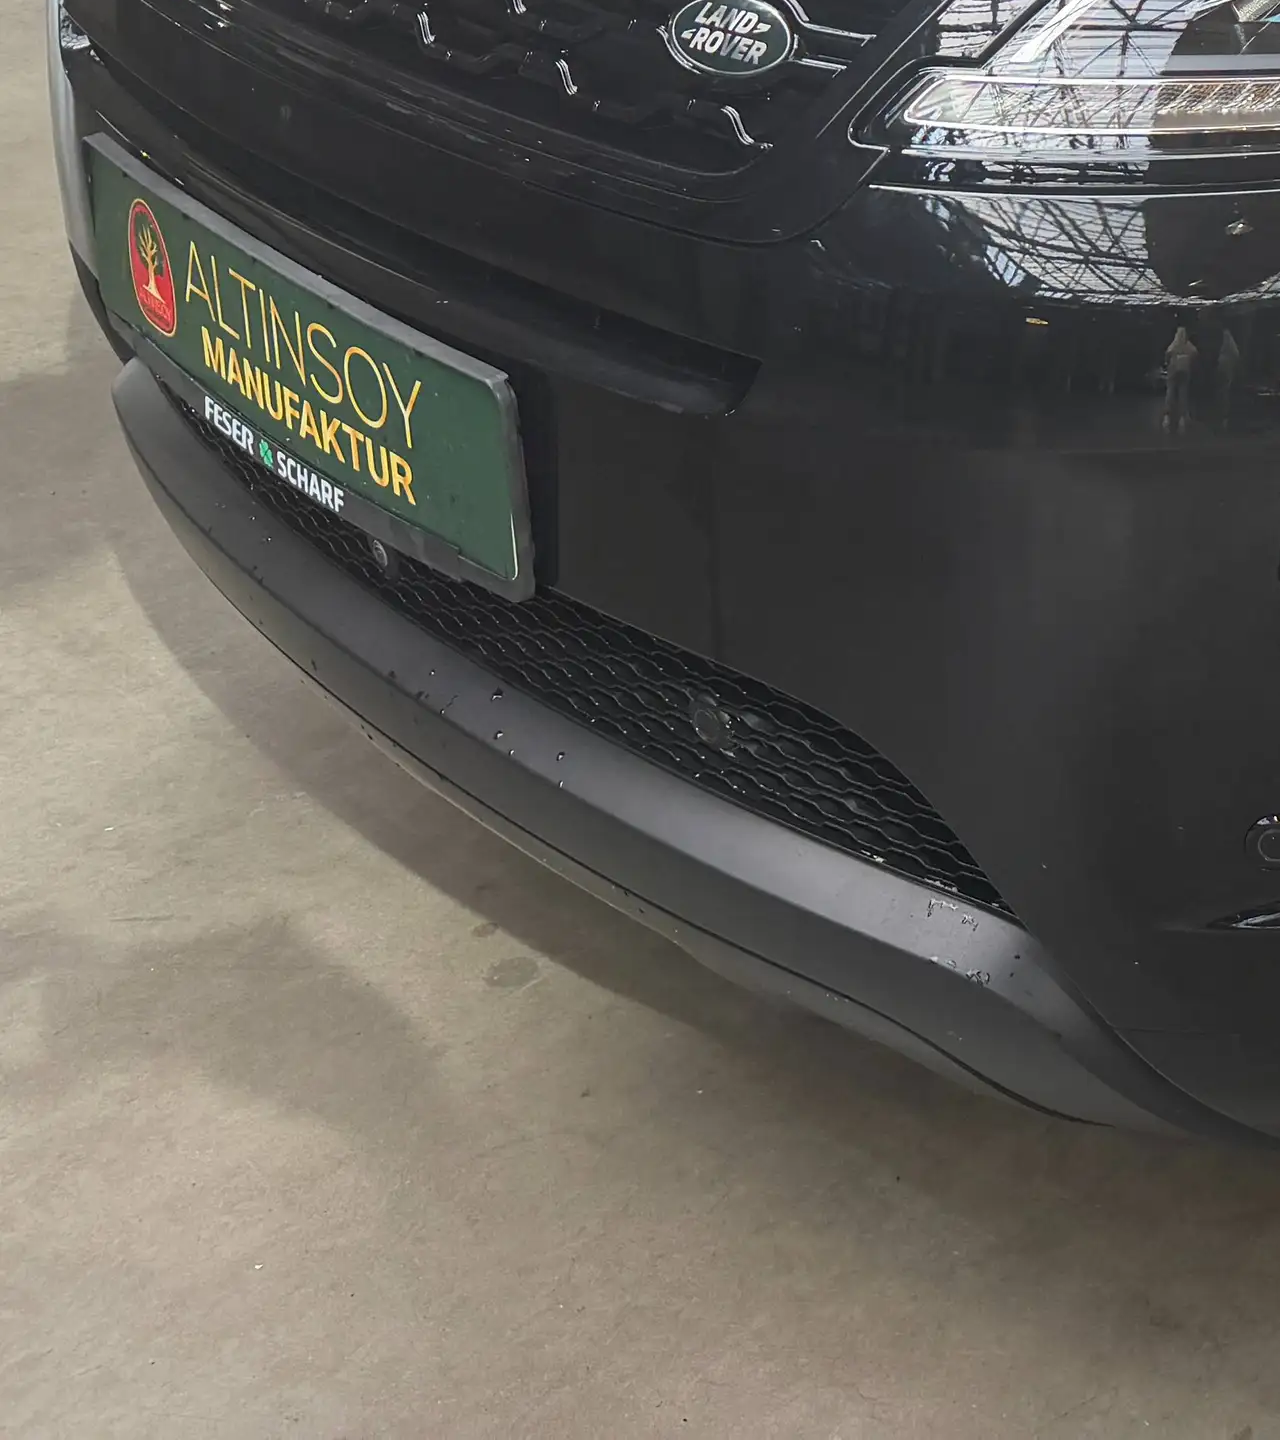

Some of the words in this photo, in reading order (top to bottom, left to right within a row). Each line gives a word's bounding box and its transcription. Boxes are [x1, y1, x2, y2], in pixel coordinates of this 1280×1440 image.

[689, 26, 767, 65] ROVER
[695, 2, 759, 34] LAND
[185, 241, 421, 449] ALTINSOY
[202, 326, 416, 505] MANUFAKTUR
[204, 395, 254, 455] FESER
[276, 450, 345, 512] SCHARF
